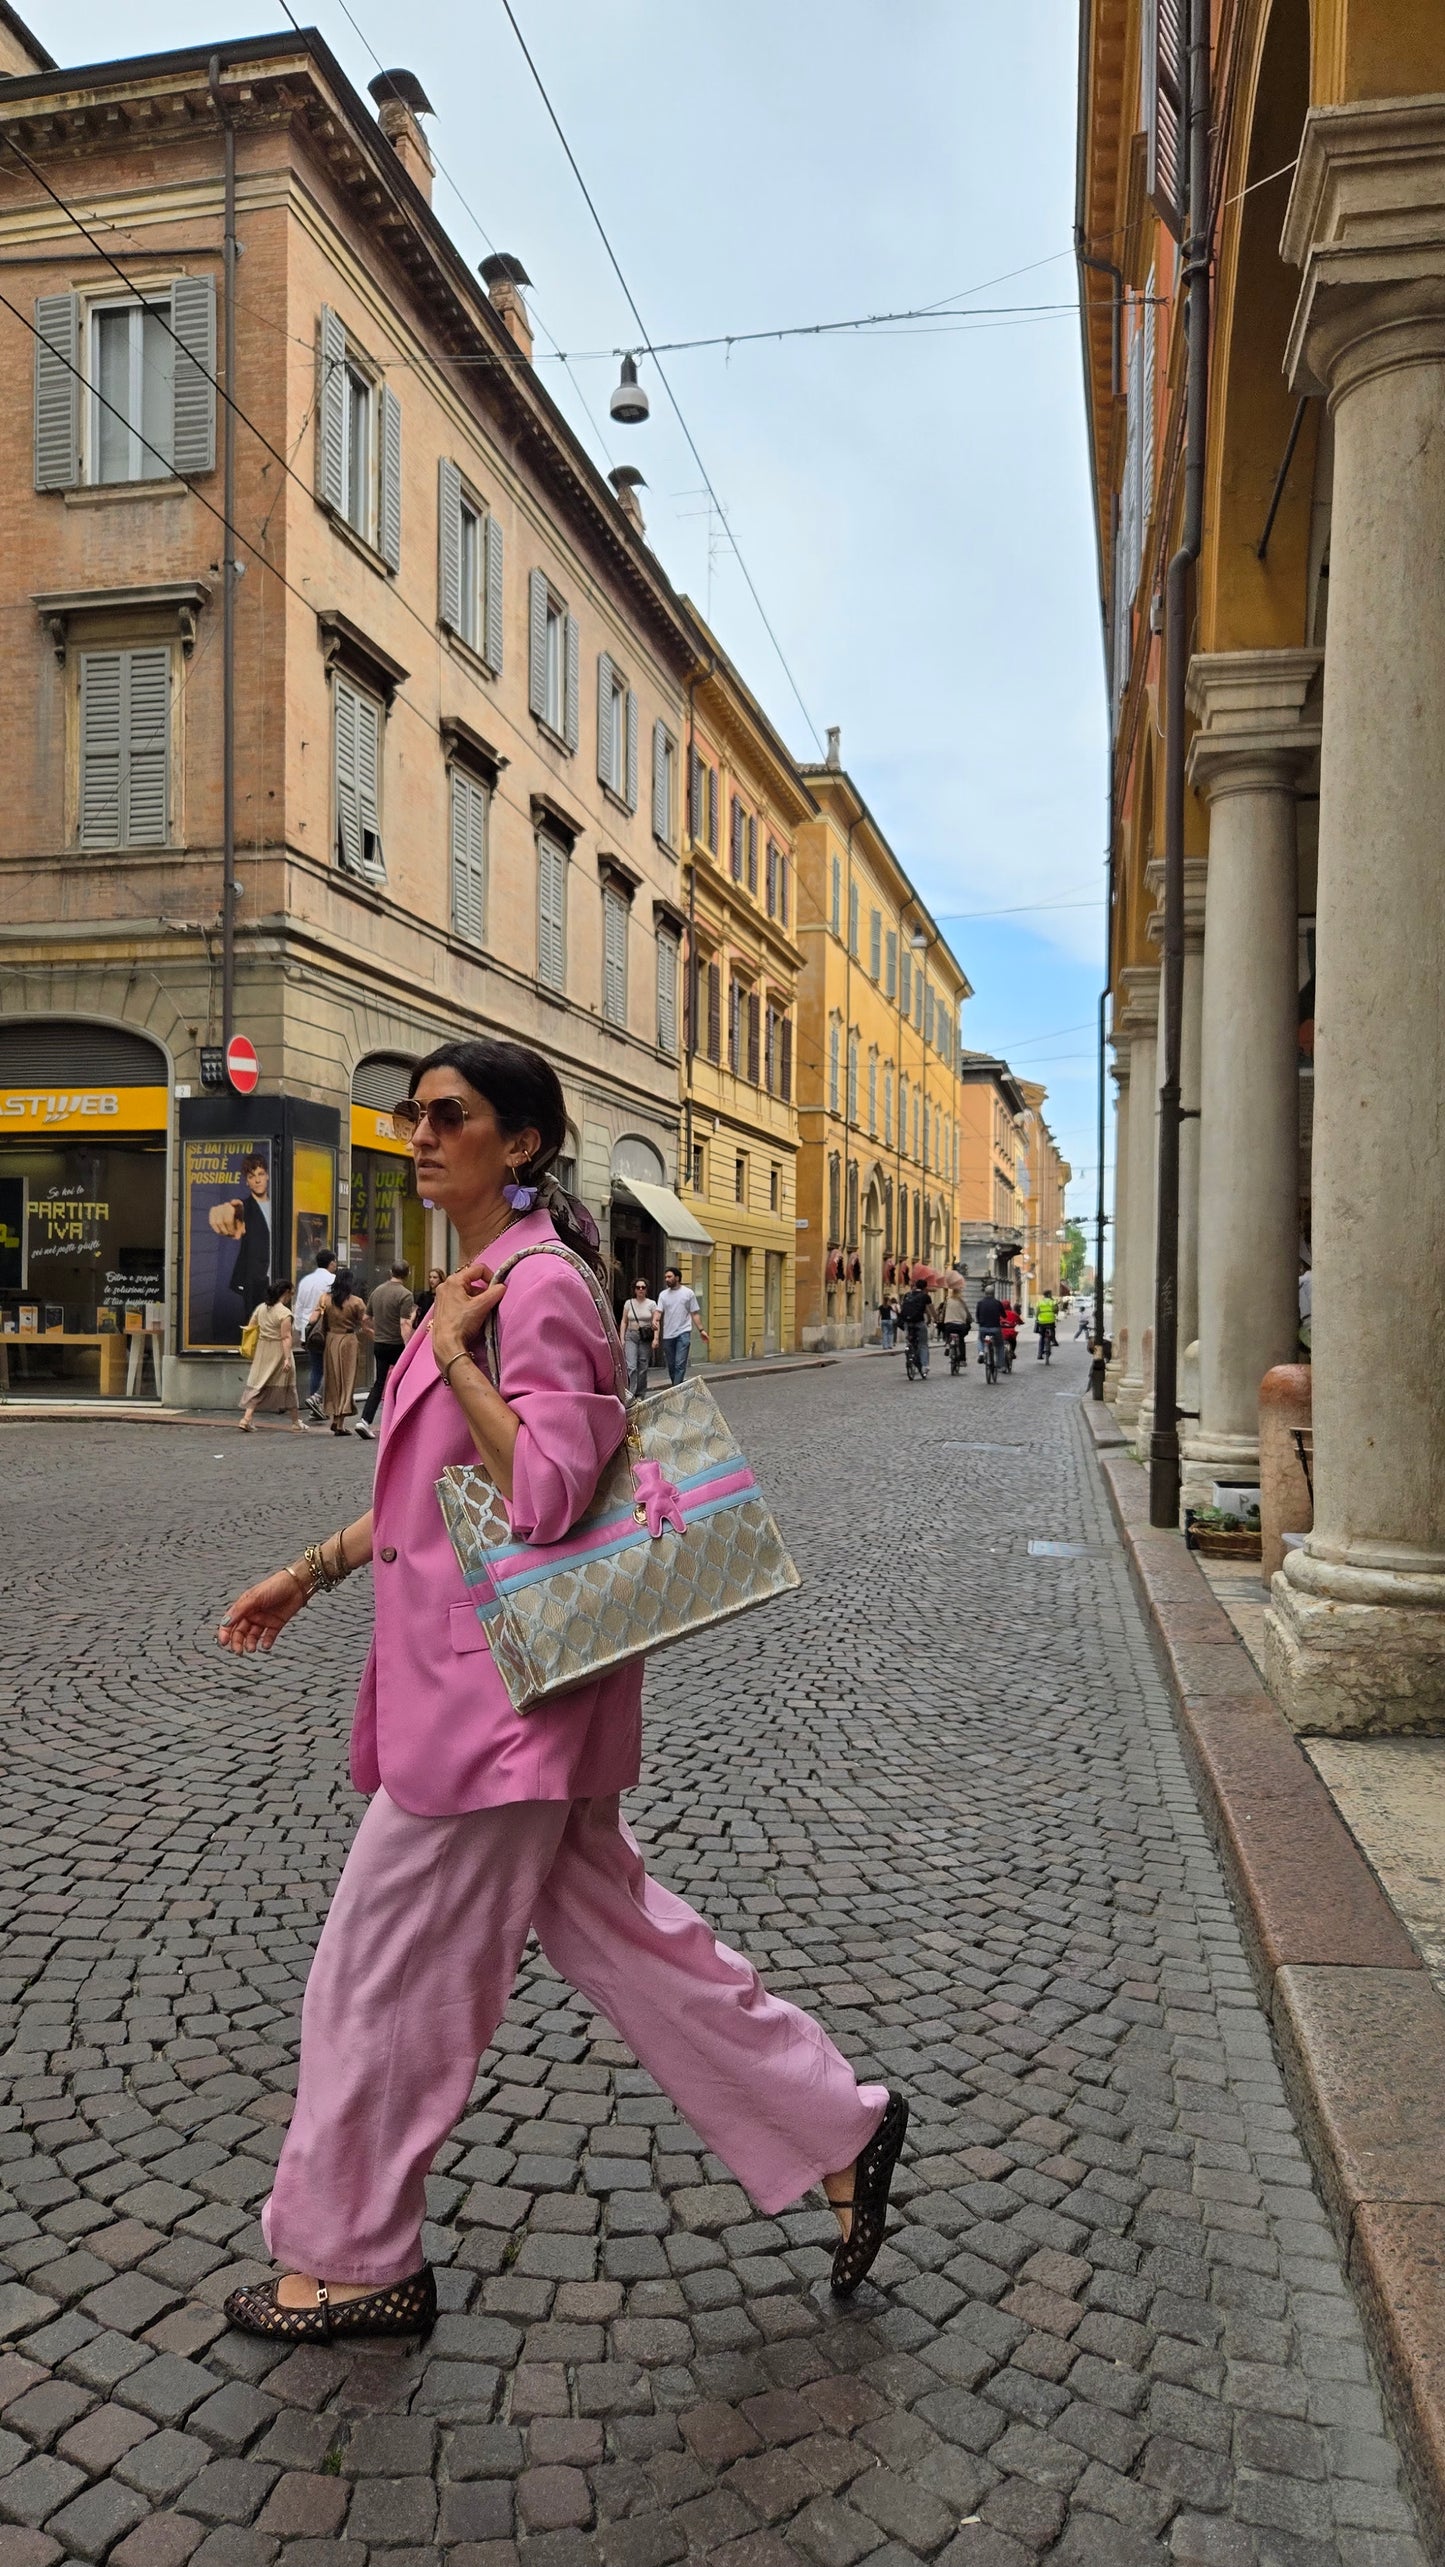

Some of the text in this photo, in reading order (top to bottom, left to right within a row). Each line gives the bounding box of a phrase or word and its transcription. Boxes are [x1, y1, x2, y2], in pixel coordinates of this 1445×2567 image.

[0, 1094, 119, 1124] STWEB
[190, 1142, 254, 1154] SE DAI TUTTO
[190, 1154, 229, 1170] TUTTO È
[191, 1171, 241, 1185] POSSIBILE
[46, 1186, 60, 1200] Se
[26, 1201, 110, 1220] PARTITA
[48, 1222, 83, 1240] IVA
[145, 1287, 160, 1297] per
